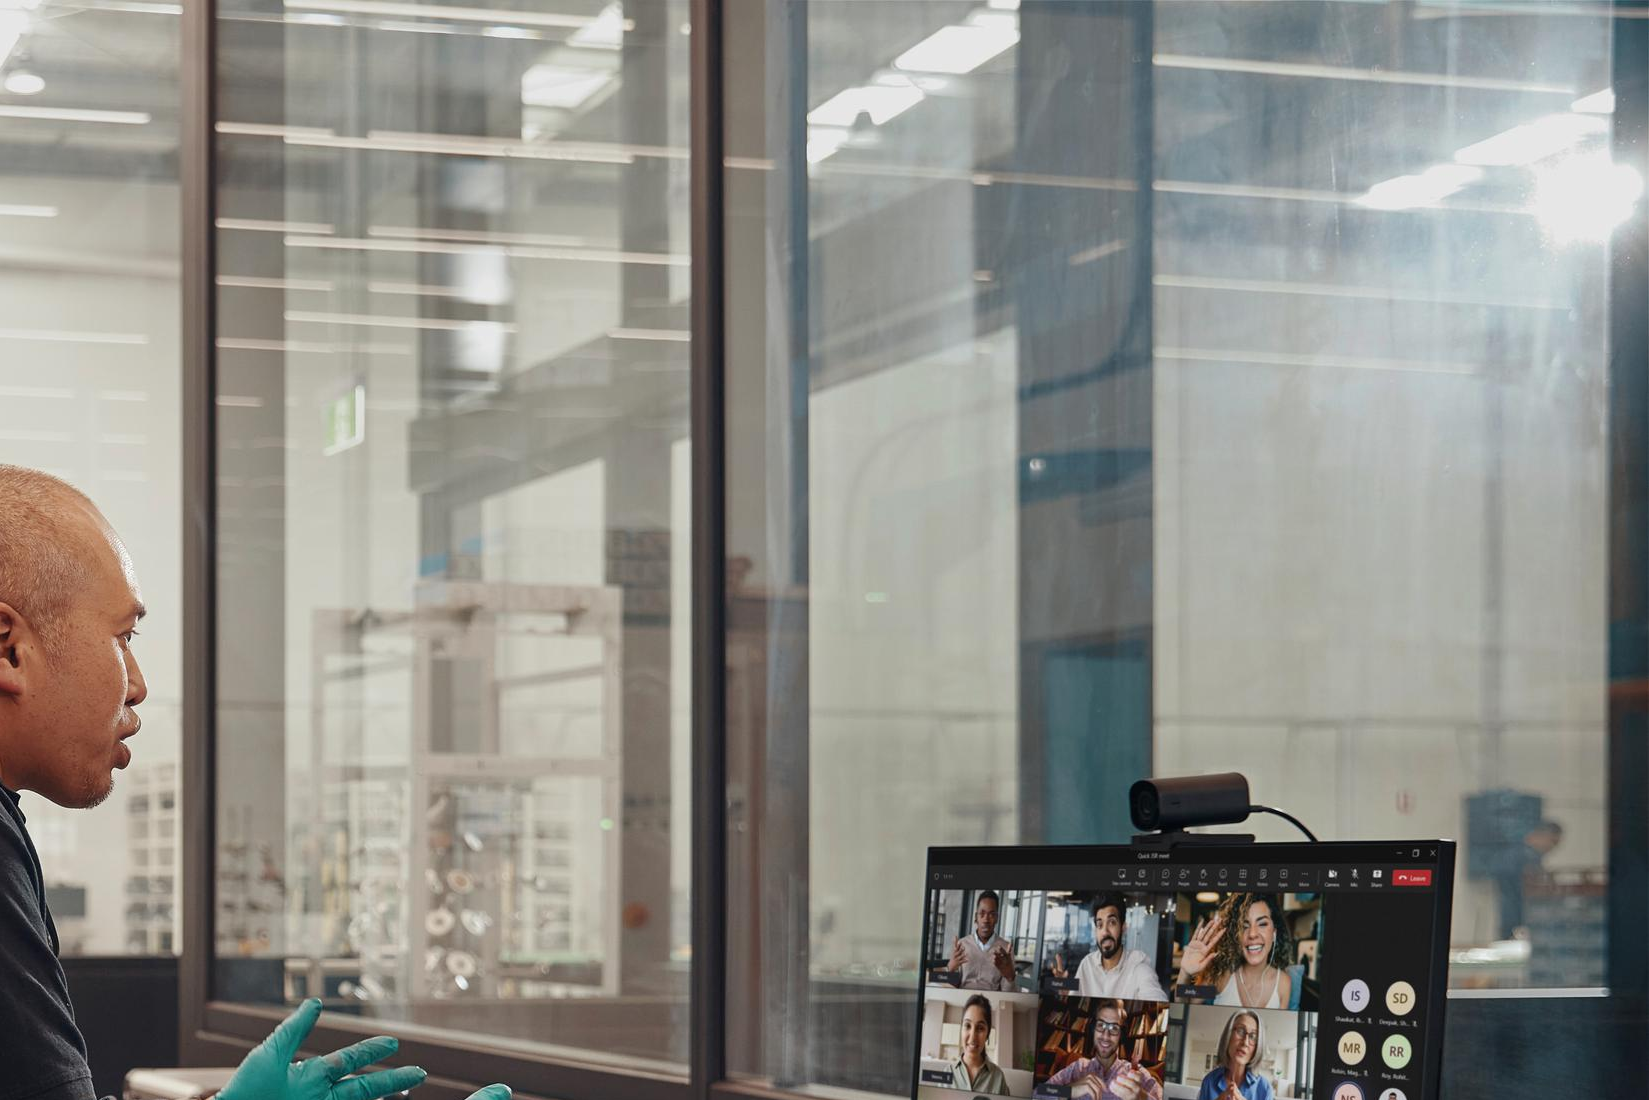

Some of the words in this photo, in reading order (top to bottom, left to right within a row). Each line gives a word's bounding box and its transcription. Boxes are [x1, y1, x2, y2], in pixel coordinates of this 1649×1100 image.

[1351, 990, 1361, 1001] IS
[1392, 992, 1408, 1004] SD
[1343, 1042, 1361, 1054] MR
[1390, 1046, 1404, 1058] RR
